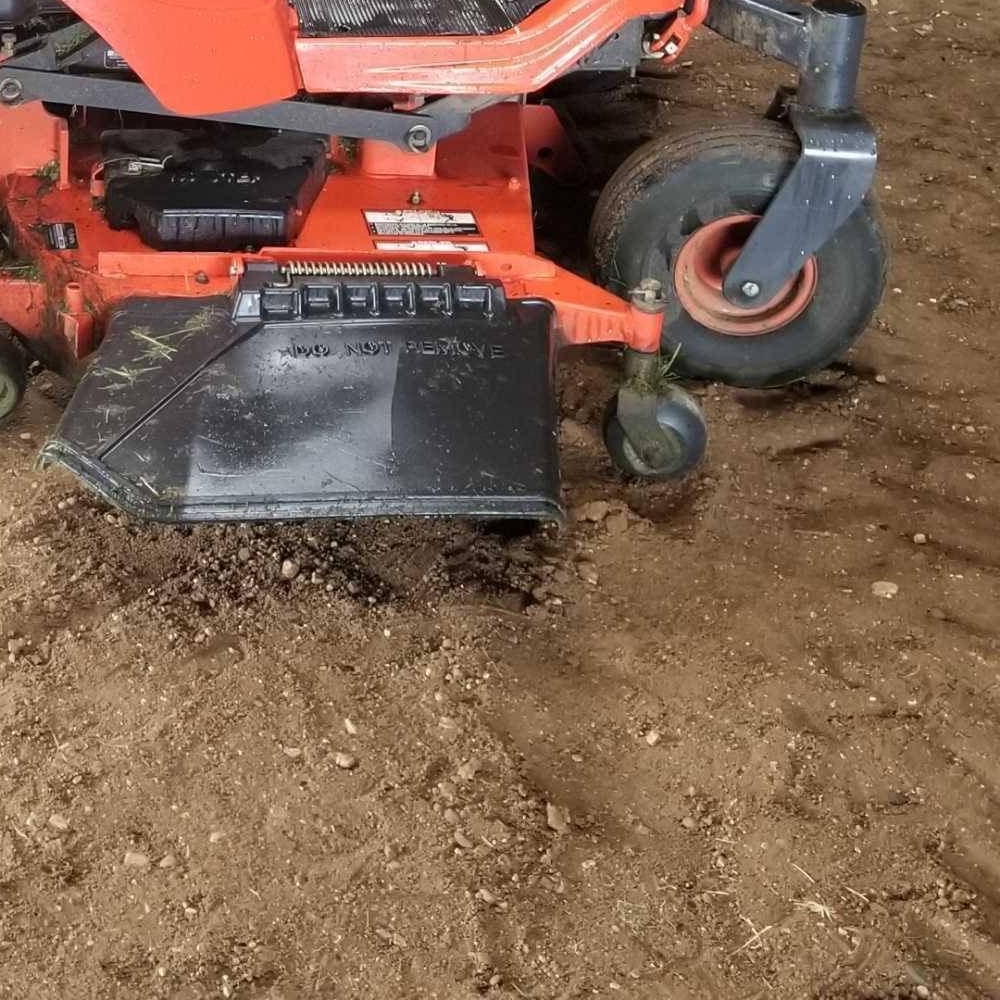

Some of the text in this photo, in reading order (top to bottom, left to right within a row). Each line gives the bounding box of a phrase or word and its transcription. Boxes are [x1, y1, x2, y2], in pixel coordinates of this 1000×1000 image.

[292, 339, 505, 359] DO NOT REMOVE
